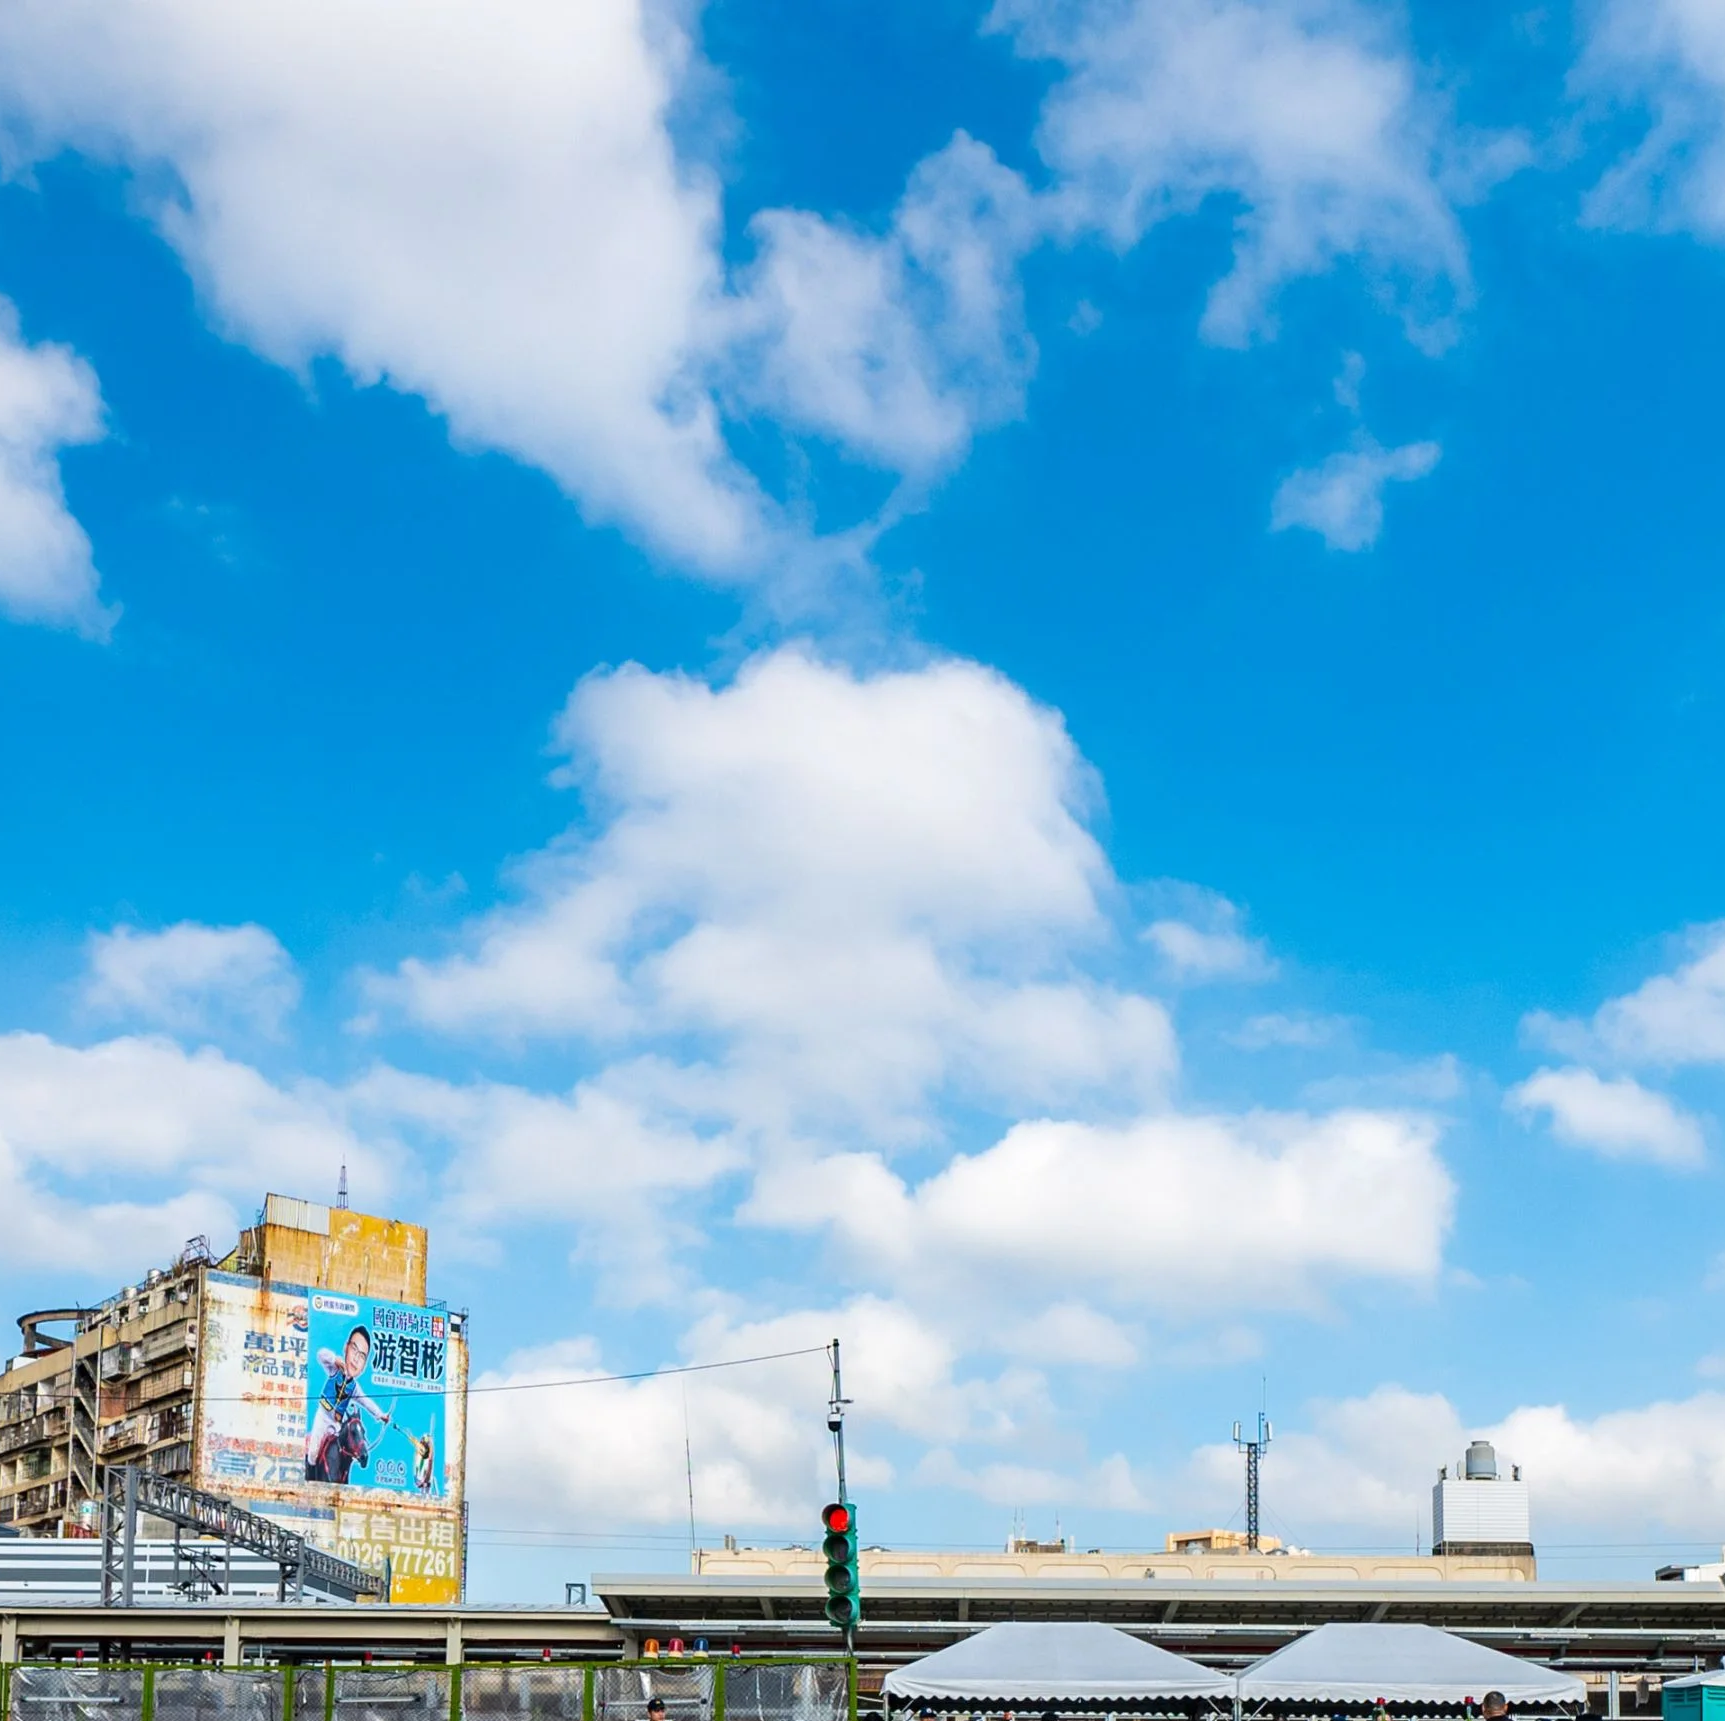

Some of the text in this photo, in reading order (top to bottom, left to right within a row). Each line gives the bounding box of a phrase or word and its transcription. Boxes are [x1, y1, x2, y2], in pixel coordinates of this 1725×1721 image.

[373, 1306, 430, 1335] 國會游騎兵
[372, 1332, 443, 1379] 游智彬
[340, 1512, 455, 1549] 廣告出租
[389, 1545, 455, 1577] 777261
